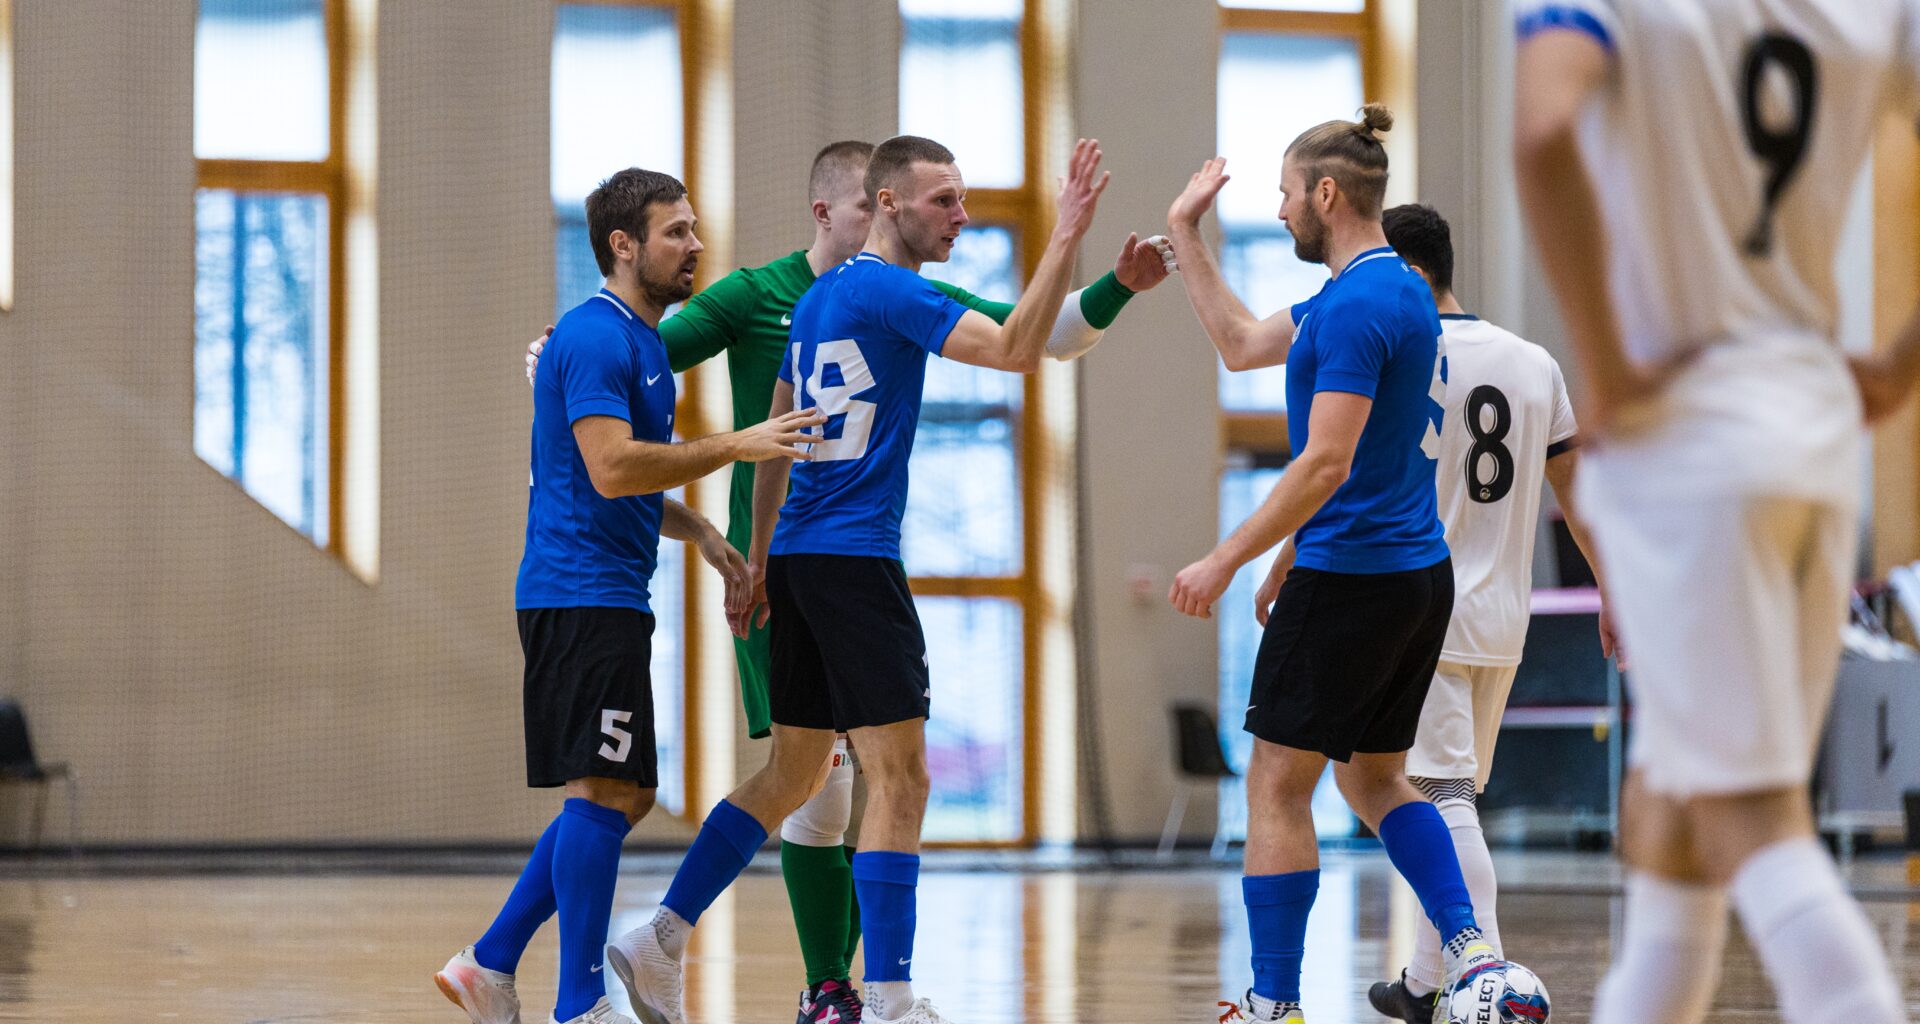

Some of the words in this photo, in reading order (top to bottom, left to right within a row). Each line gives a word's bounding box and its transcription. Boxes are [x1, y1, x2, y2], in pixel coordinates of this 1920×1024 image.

[1738, 31, 1819, 257] 9
[791, 338, 877, 463] 18
[1463, 384, 1515, 504] 8
[598, 708, 633, 763] 5
[1477, 978, 1495, 1024] ELECT
